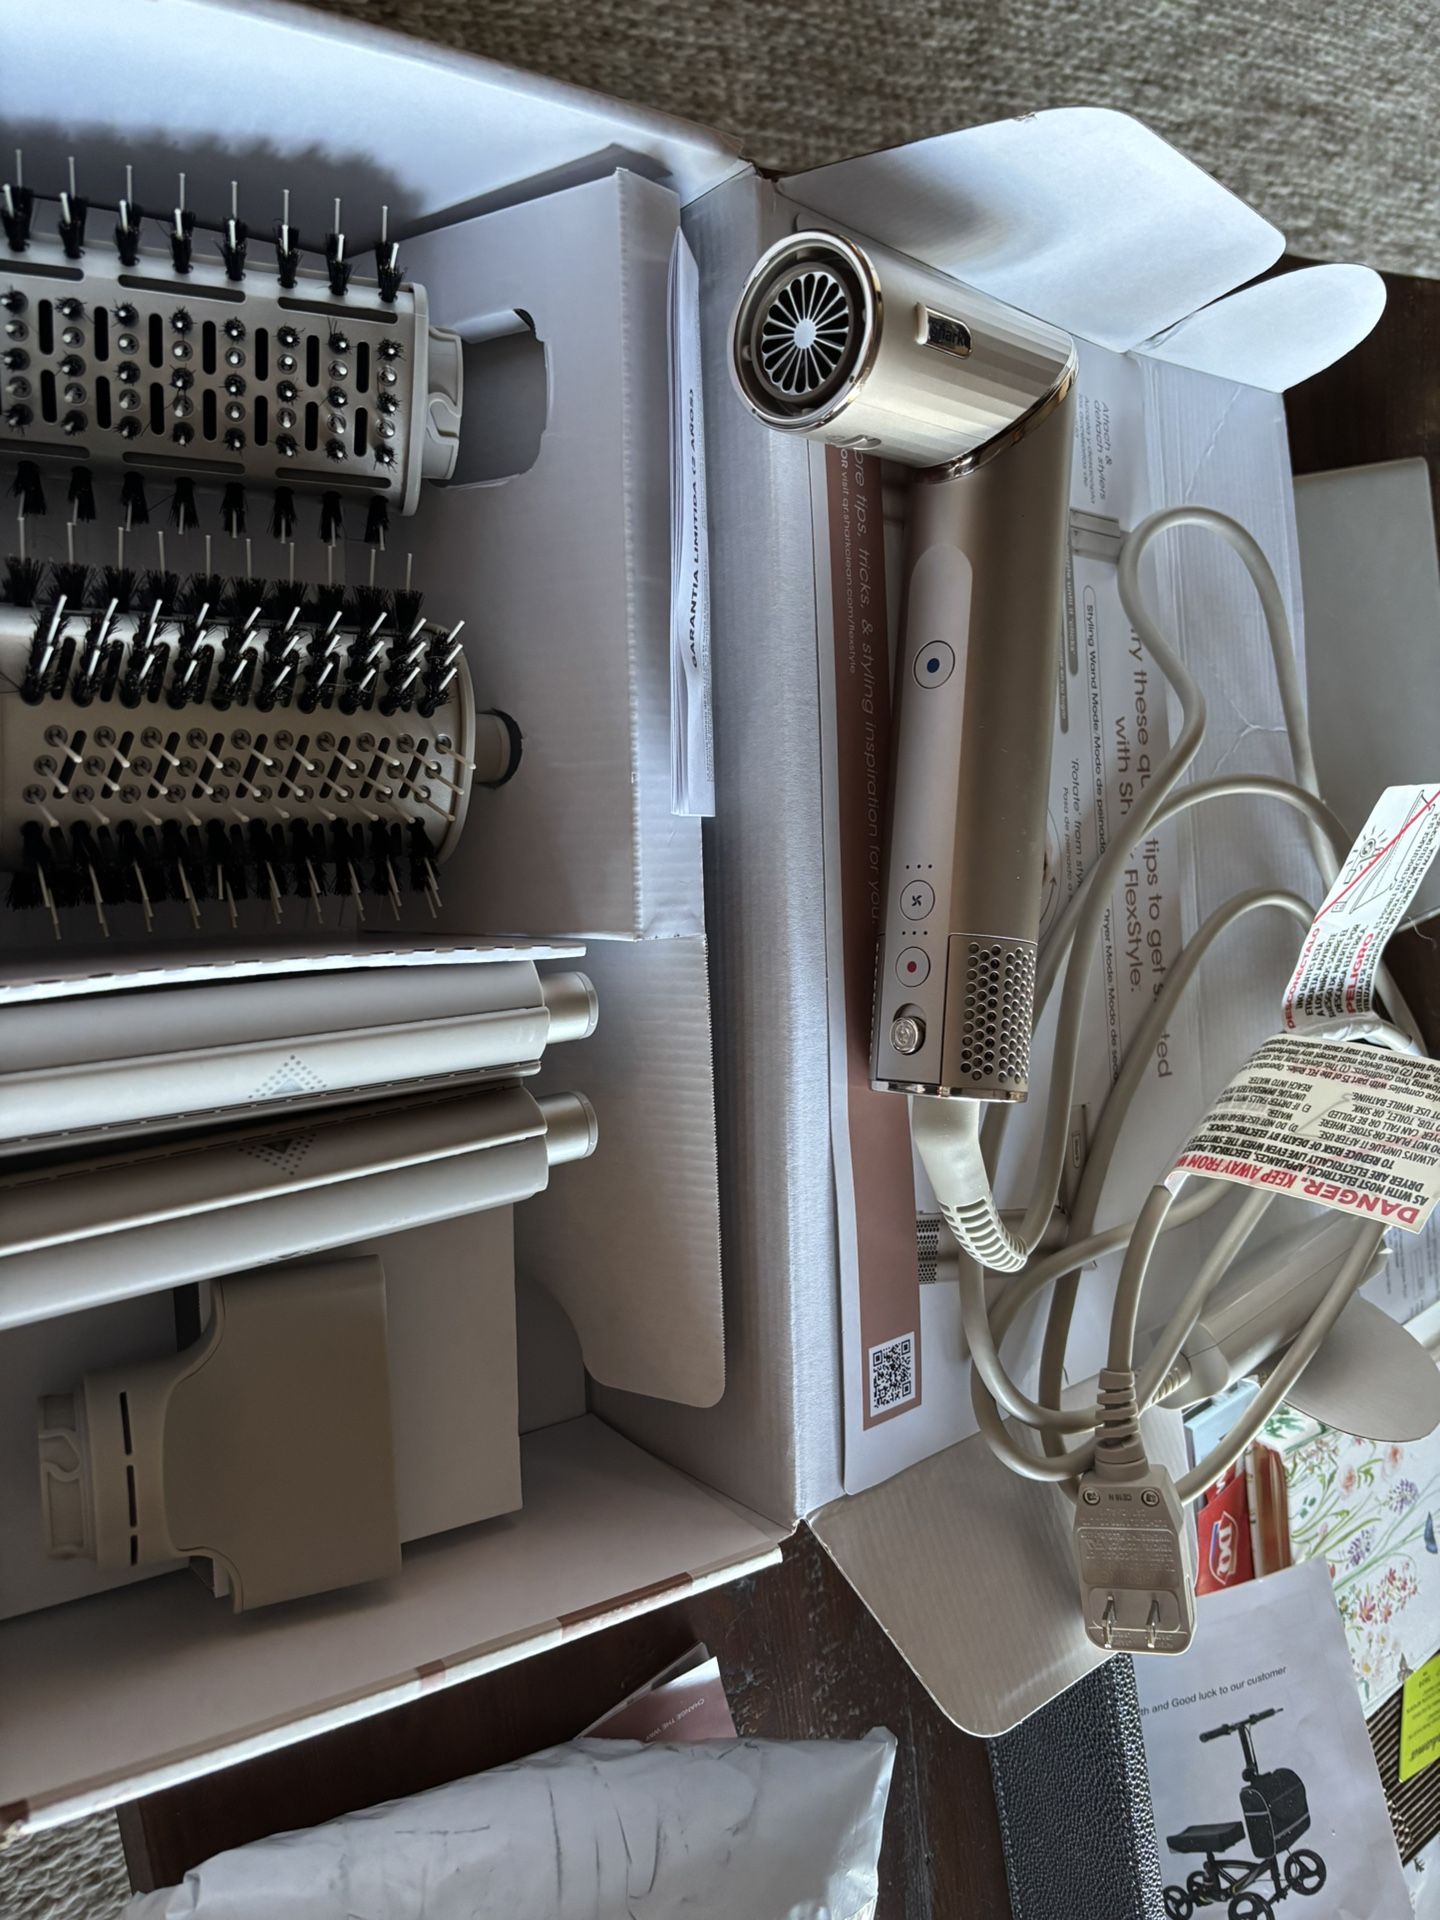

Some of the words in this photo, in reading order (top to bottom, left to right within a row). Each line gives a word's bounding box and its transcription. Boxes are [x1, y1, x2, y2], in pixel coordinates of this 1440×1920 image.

[1094, 400, 1102, 453] detach
[1102, 402, 1111, 451] Attach
[840, 449, 849, 469] OR
[1105, 456, 1112, 465] &
[854, 450, 864, 487] ore
[841, 471, 849, 495] visit
[1096, 456, 1105, 500] stylers
[853, 494, 868, 537] tips,
[859, 548, 871, 608] tricks,
[689, 569, 699, 668] GARANTIA
[861, 619, 874, 637] &
[1086, 604, 1095, 647] Styling
[1089, 651, 1098, 690] Wand
[860, 643, 876, 714] styling
[1133, 670, 1149, 745] these
[863, 720, 880, 837] inspiration
[1095, 778, 1103, 796] de
[1095, 799, 1107, 855] peinado
[1073, 821, 1082, 855] from
[868, 844, 881, 873] for
[1115, 716, 1130, 773] with
[1125, 869, 1143, 992] FlexStyle.
[1143, 838, 1159, 885] tips
[867, 880, 880, 925] you.
[1148, 894, 1162, 920] to
[1146, 929, 1166, 974] get
[1285, 927, 1320, 1029] DESCONÉCTALO
[1345, 932, 1374, 1013] PELIGRO
[1314, 992, 1323, 1008] LOS
[1110, 1029, 1117, 1046] de
[1313, 1049, 1338, 1061] accept
[1321, 1044, 1343, 1054] cause
[1342, 1045, 1361, 1057] may
[1360, 1050, 1378, 1060] that
[1299, 1058, 1323, 1068] device
[1323, 1061, 1338, 1069] This
[1337, 1055, 1357, 1065] must
[1356, 1058, 1383, 1070] device
[1377, 1054, 1426, 1070] interference
[1306, 1067, 1319, 1075] FCC
[1338, 1062, 1351, 1072] (1)
[1383, 1064, 1399, 1073] this
[1398, 1067, 1413, 1077] (2)
[1319, 1070, 1332, 1078] the
[1331, 1072, 1342, 1080] of
[1341, 1074, 1351, 1082] 15
[1350, 1066, 1394, 1082] conditions:
[1350, 1074, 1369, 1086] part
[1412, 1070, 1430, 1080] and
[1270, 1078, 1288, 1087] INTO
[1287, 1080, 1312, 1091] REACH
[1368, 1080, 1387, 1090] with
[1394, 1076, 1410, 1086] two
[1276, 1089, 1306, 1101] UNPLUG
[1387, 1082, 1425, 1098] complies
[1247, 1095, 1268, 1104] FALLS
[1266, 1097, 1292, 1108] DRYER
[1350, 1092, 1387, 1106] BATHING.
[1384, 1099, 1413, 1112] WHILE
[1290, 1102, 1300, 1110] IF
[1301, 1104, 1311, 1112] E)
[1350, 1103, 1371, 1114] SINK.
[1413, 1106, 1431, 1116] USE
[1266, 1108, 1293, 1120] WATER.
[1327, 1109, 1357, 1122] PULLED
[1371, 1108, 1385, 1118] OR
[1386, 1111, 1414, 1124] TOILET,
[1258, 1118, 1275, 1127] NOT
[1273, 1120, 1287, 1130] DO
[1318, 1118, 1347, 1131] WHERE
[1355, 1116, 1368, 1125] BE
[1367, 1118, 1381, 1128] OR
[1381, 1122, 1401, 1132] FALL
[1415, 1118, 1435, 1129] TUB,
[1231, 1124, 1268, 1138] ELECTRIC
[1287, 1123, 1298, 1132] D)
[1346, 1124, 1372, 1137] STORE
[1400, 1126, 1419, 1137] CAN
[1222, 1136, 1239, 1146] THE
[1267, 1131, 1281, 1141] BY
[1280, 1134, 1309, 1147] DEATH
[1316, 1130, 1335, 1141] USE.
[1333, 1134, 1360, 1147] AFTER
[1370, 1130, 1386, 1140] OR
[1384, 1133, 1412, 1146] PLACE
[1238, 1139, 1265, 1151] WHEN
[1263, 1144, 1288, 1156] EVEN
[1308, 1140, 1322, 1150] OF
[1322, 1144, 1344, 1156] RISK
[1358, 1140, 1369, 1149] IT
[1368, 1142, 1402, 1157] UNPLUG
[1411, 1139, 1430, 1150] NOT
[1206, 1145, 1251, 1159] ELECTRICAL
[1284, 1149, 1307, 1160] LIVE
[1342, 1149, 1381, 1165] REDUCE
[1401, 1150, 1438, 1165] ALWAYS
[1186, 1154, 1223, 1171] FROM
[1221, 1159, 1262, 1178] AWAY
[1252, 1152, 1306, 1172] APPLIANCES,
[1305, 1154, 1369, 1177] ELECTRICALLY
[1380, 1158, 1394, 1168] TO
[1259, 1168, 1297, 1187] KEEP
[1305, 1166, 1358, 1186] ELECTRICAL
[1368, 1170, 1389, 1182] ARE
[1355, 1178, 1385, 1193] MOST
[1388, 1175, 1423, 1191] DRYER
[1298, 1178, 1420, 1221] DANGER.
[1384, 1186, 1412, 1201] WITH
[1412, 1194, 1428, 1205] AS
[1215, 1525, 1233, 1576] DQ
[1151, 1701, 1169, 1713] and
[1171, 1693, 1197, 1708] Good
[1198, 1688, 1217, 1702] luck
[1218, 1686, 1228, 1696] to
[1229, 1680, 1245, 1692] our
[1246, 1666, 1287, 1686] customer
[676, 1699, 704, 1720] CHANGE
